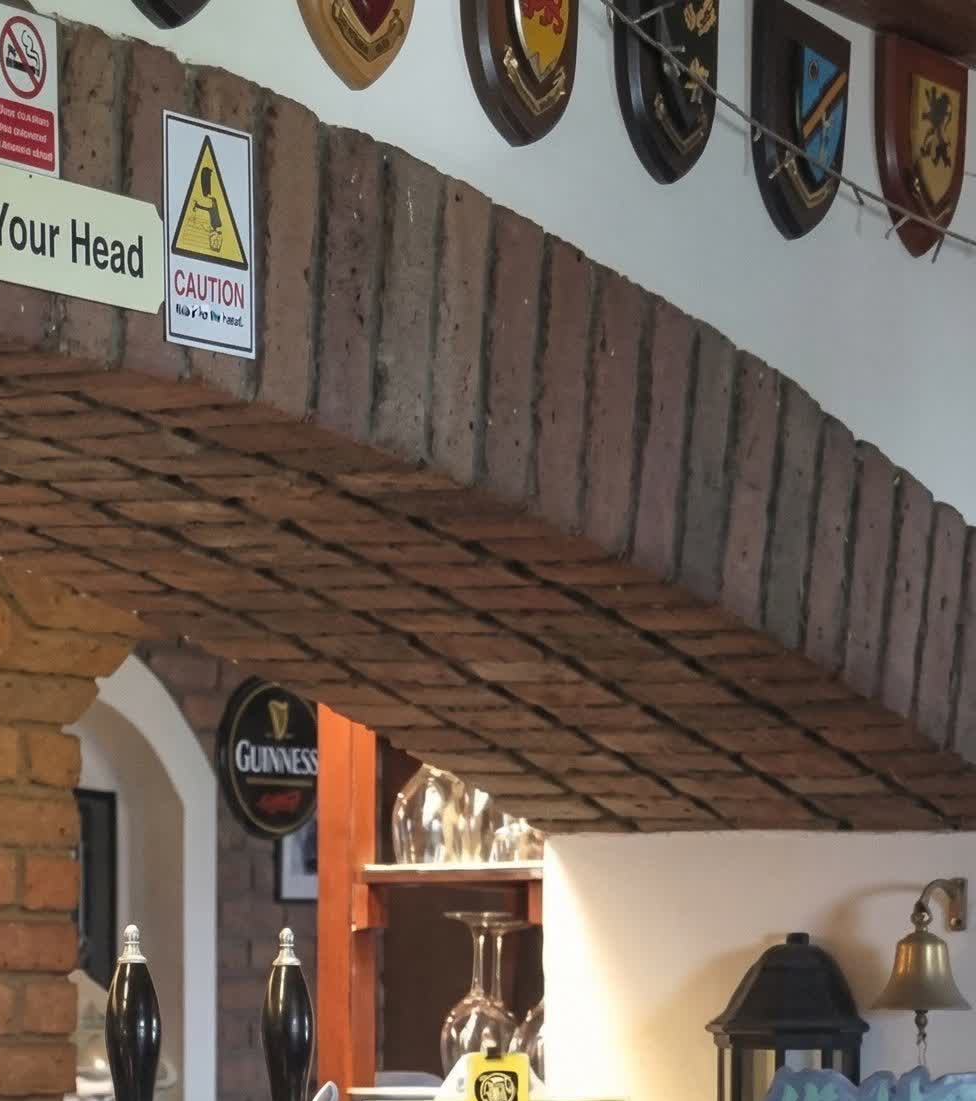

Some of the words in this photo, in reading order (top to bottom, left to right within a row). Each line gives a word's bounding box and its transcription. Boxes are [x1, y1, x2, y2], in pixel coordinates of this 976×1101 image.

[71, 218, 144, 279] Head
[174, 269, 244, 309] CAUTION
[235, 739, 318, 777] GUINNESS
